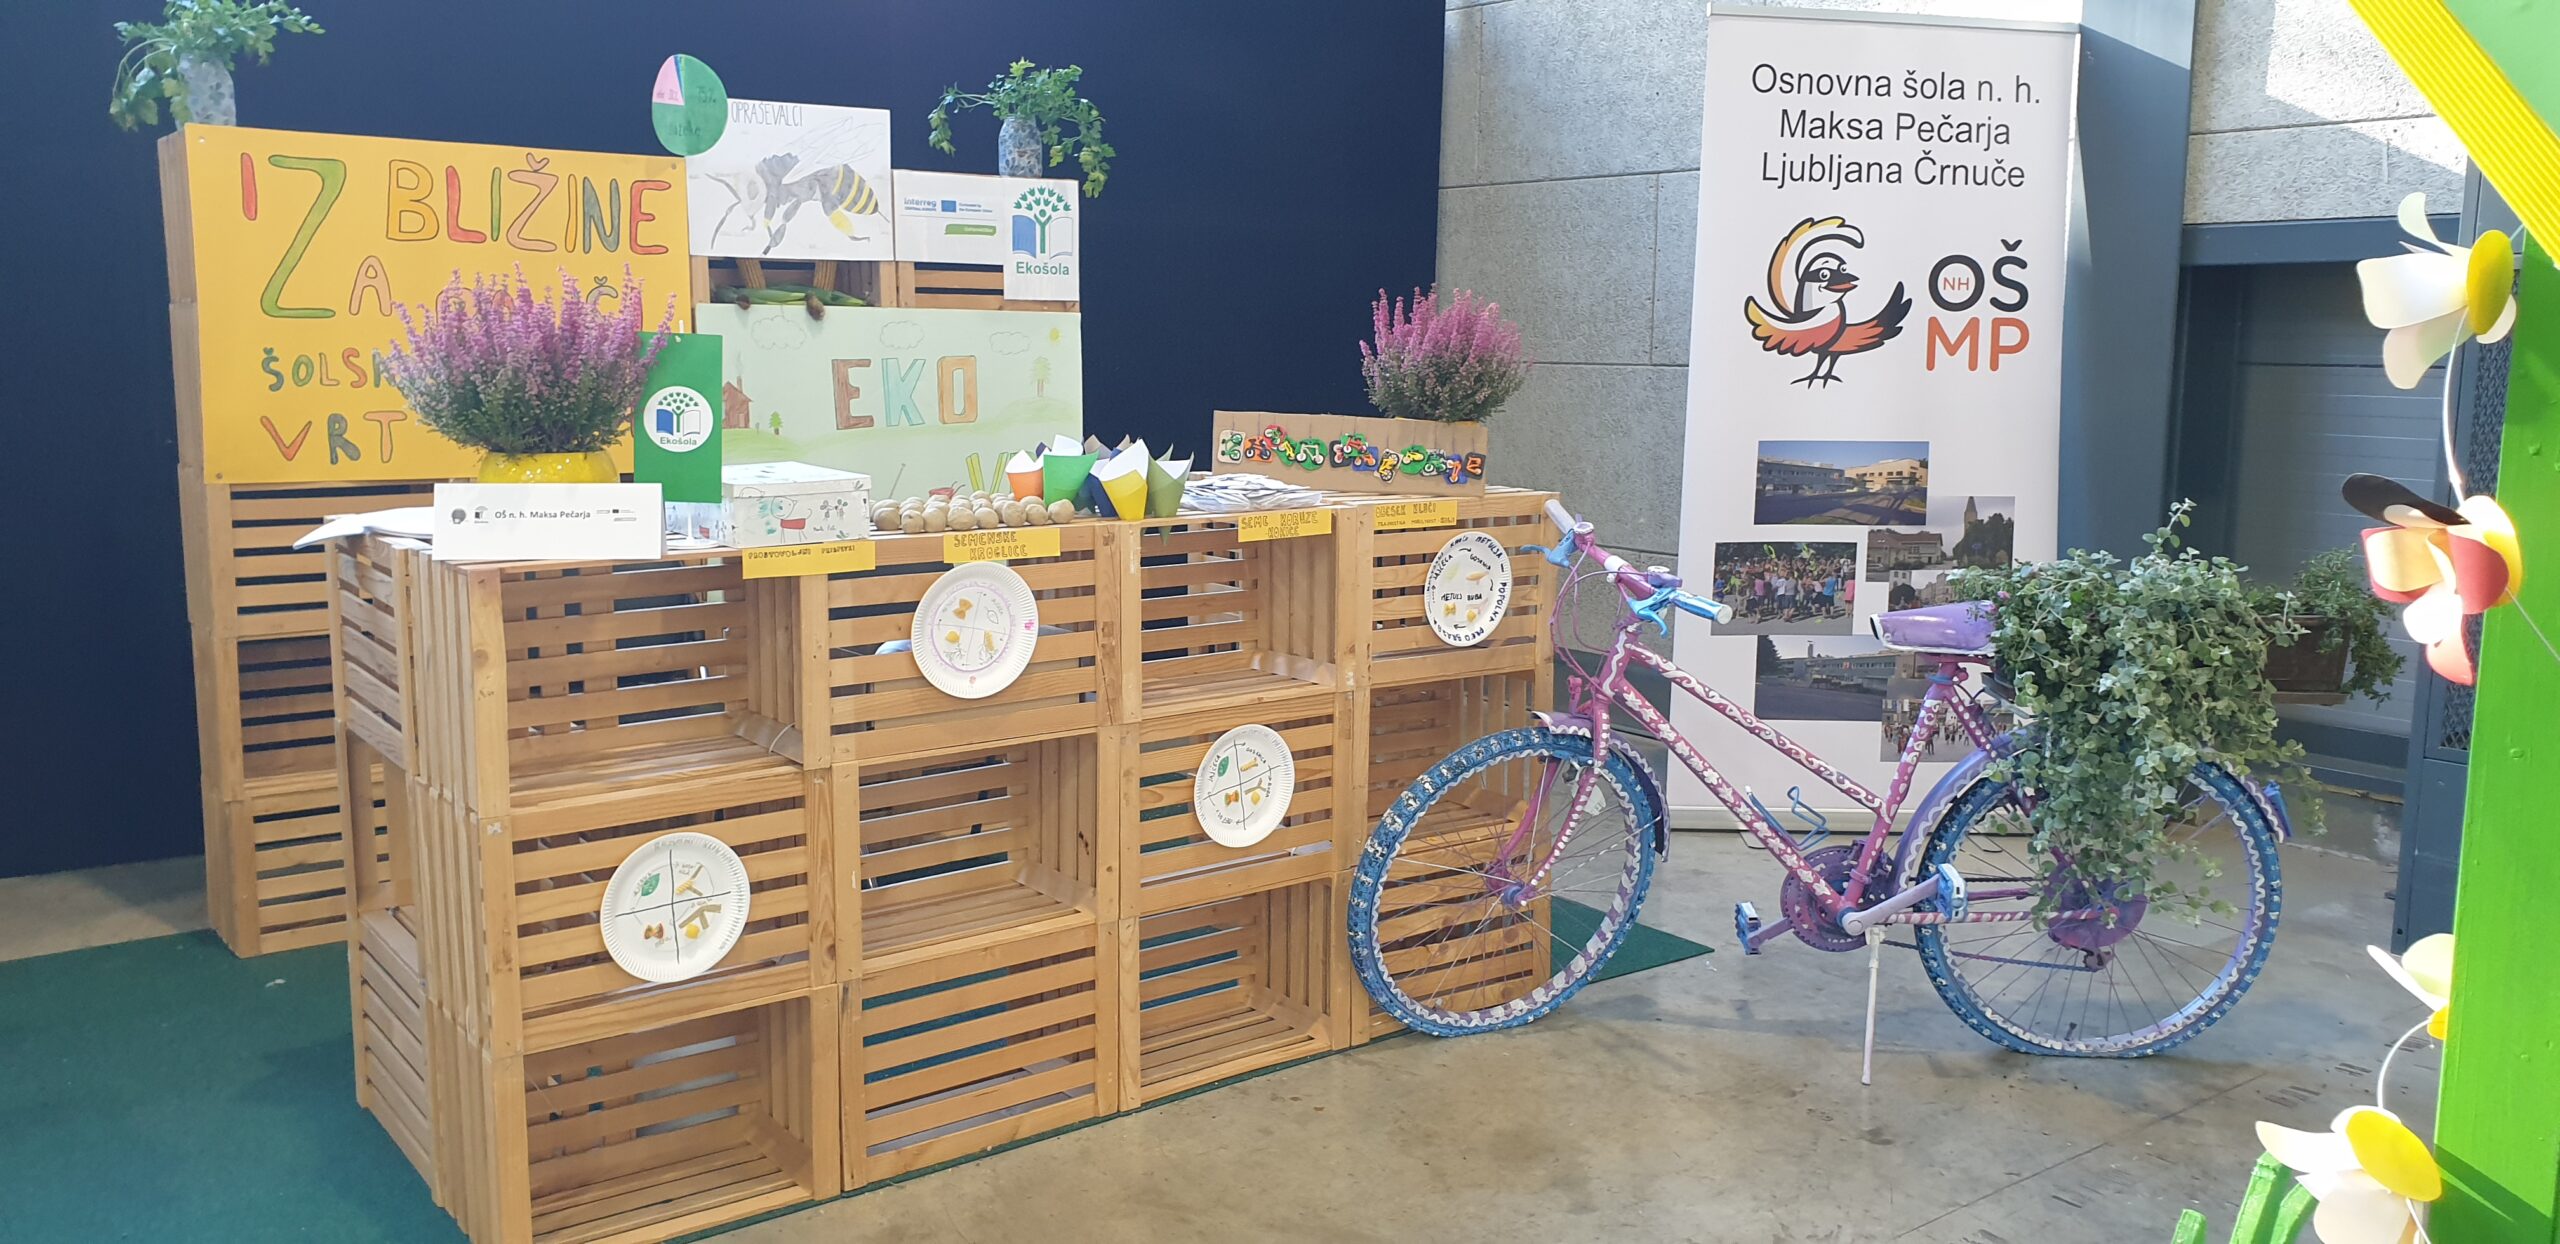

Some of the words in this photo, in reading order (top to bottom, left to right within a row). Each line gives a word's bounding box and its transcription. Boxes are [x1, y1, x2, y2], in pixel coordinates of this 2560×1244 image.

[1751, 63, 1891, 98] Osnovna
[1903, 69, 1965, 101] šola
[1978, 80, 2002, 103] n.
[2015, 75, 2041, 104] h.
[731, 101, 803, 127] OPRAŠEVALCI
[1779, 108, 1883, 141] Maksa
[1895, 112, 2010, 152] Pečarja
[1761, 151, 1902, 190] Ljubljana
[1914, 149, 2025, 188] Črnuče
[386, 151, 671, 257] BLIŽINE
[1016, 261, 1069, 275] Ekošola
[1928, 239, 2029, 312] OŠ
[1943, 277, 1970, 291] NH
[1925, 316, 2030, 372] MP
[261, 347, 396, 392] ŠOLSK
[831, 355, 978, 430] EKO
[260, 410, 408, 465] VRT
[660, 437, 697, 446] Ekošola
[495, 509, 507, 519] OŠ
[519, 511, 527, 519] h.
[530, 511, 558, 519] Maksa
[560, 510, 591, 520] Pečarja
[1241, 515, 1269, 530] SEME
[954, 531, 1018, 548] SEMENSKE
[969, 544, 1028, 561] KROGLICE
[1467, 592, 1482, 601] BUBA
[1489, 582, 1508, 623] POPOLNA
